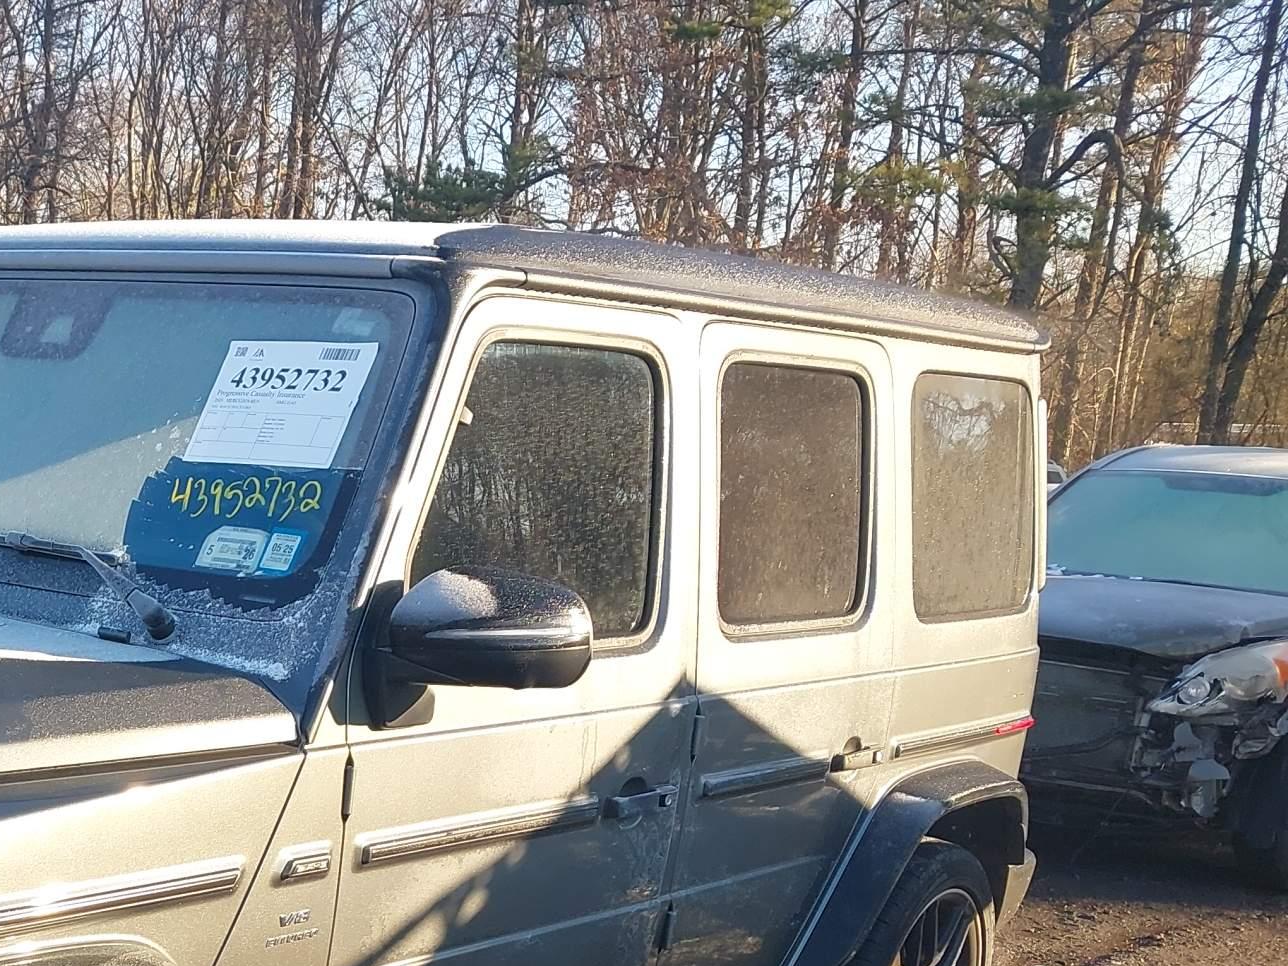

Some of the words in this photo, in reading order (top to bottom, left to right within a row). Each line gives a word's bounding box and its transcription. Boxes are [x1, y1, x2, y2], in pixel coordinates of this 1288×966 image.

[230, 367, 348, 392] 43952732
[171, 476, 322, 522] 43952732
[206, 544, 216, 556] 5
[242, 547, 256, 560] 26
